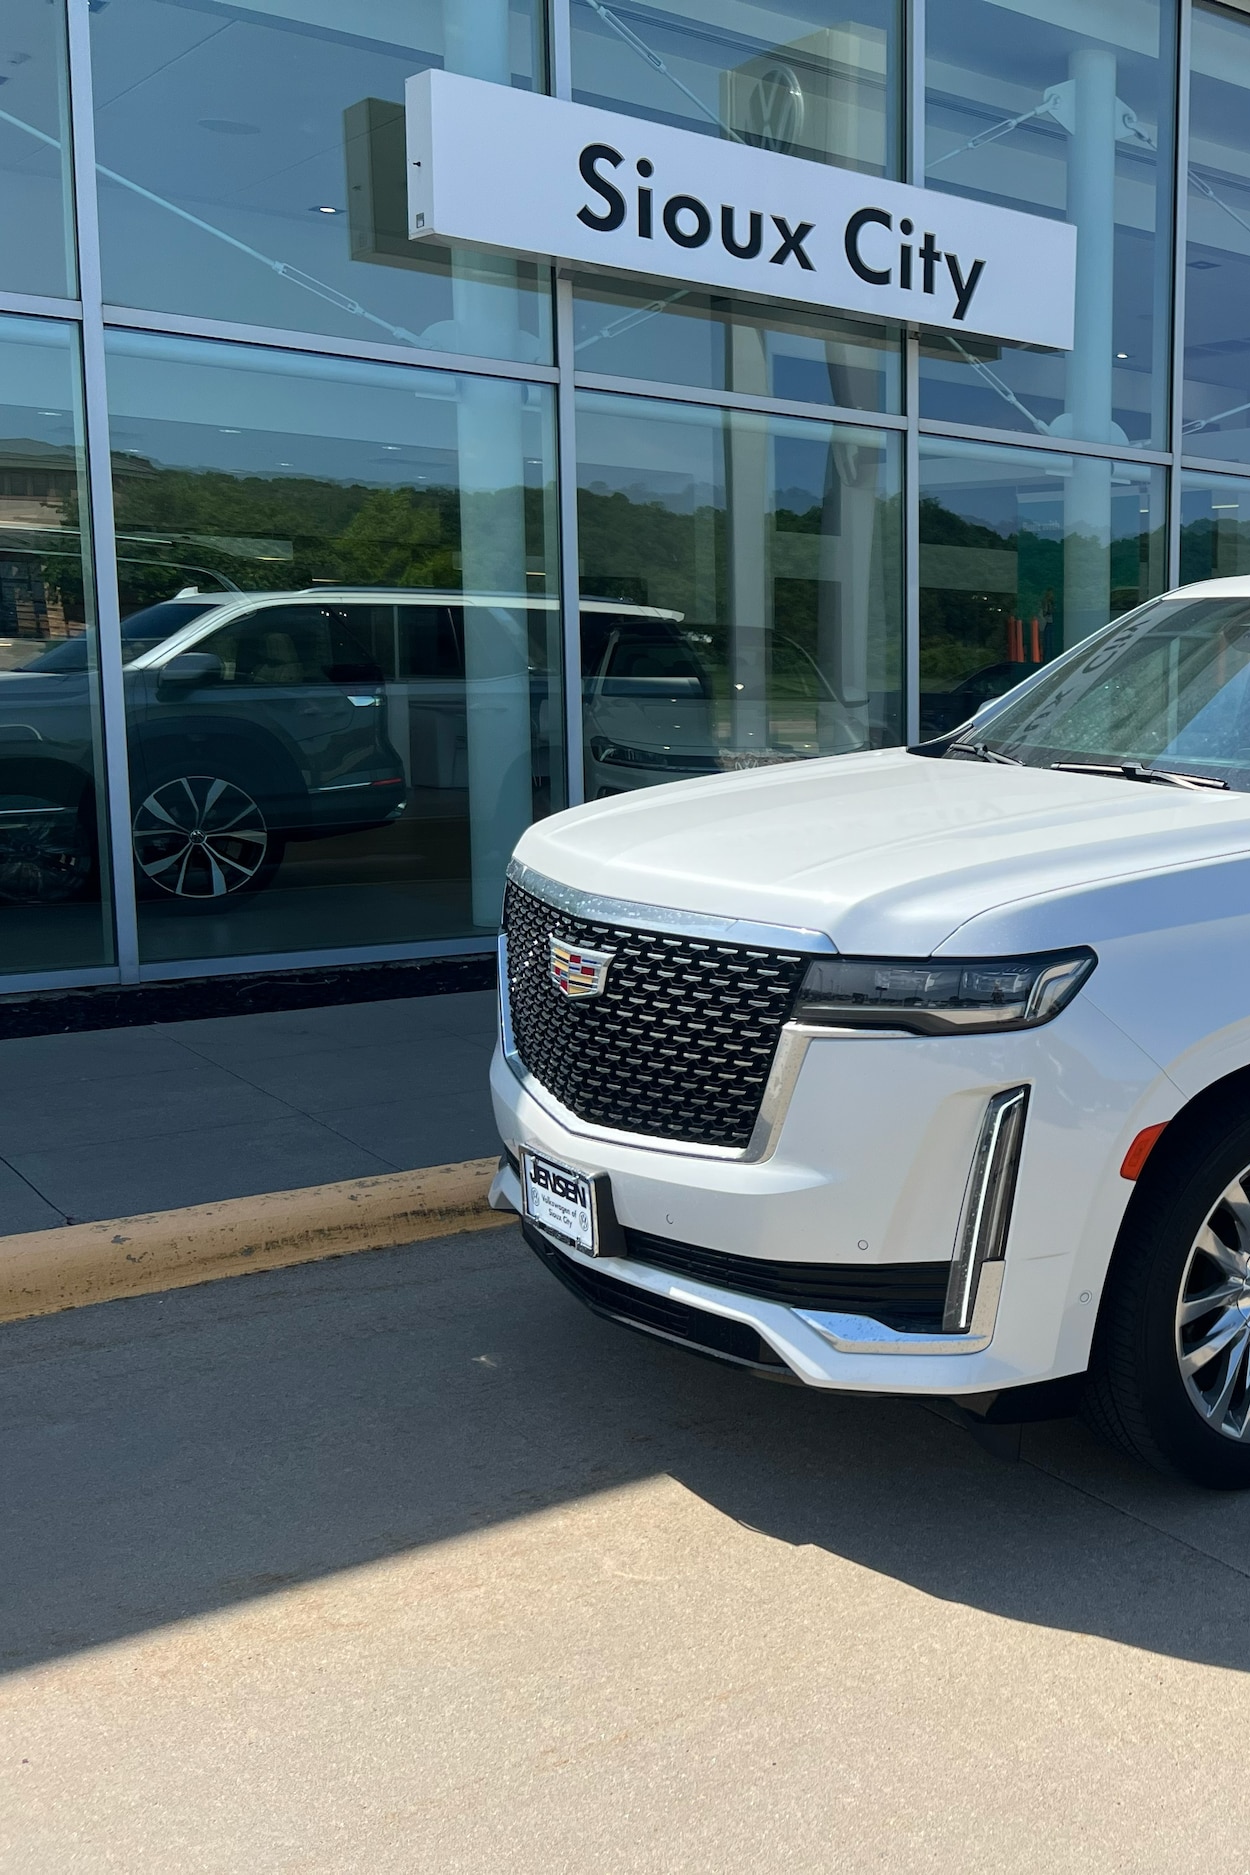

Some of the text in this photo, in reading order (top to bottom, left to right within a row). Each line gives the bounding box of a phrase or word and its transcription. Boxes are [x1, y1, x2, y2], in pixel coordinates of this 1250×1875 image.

[576, 142, 987, 321] Sioux City
[529, 1162, 587, 1209] JENSEN
